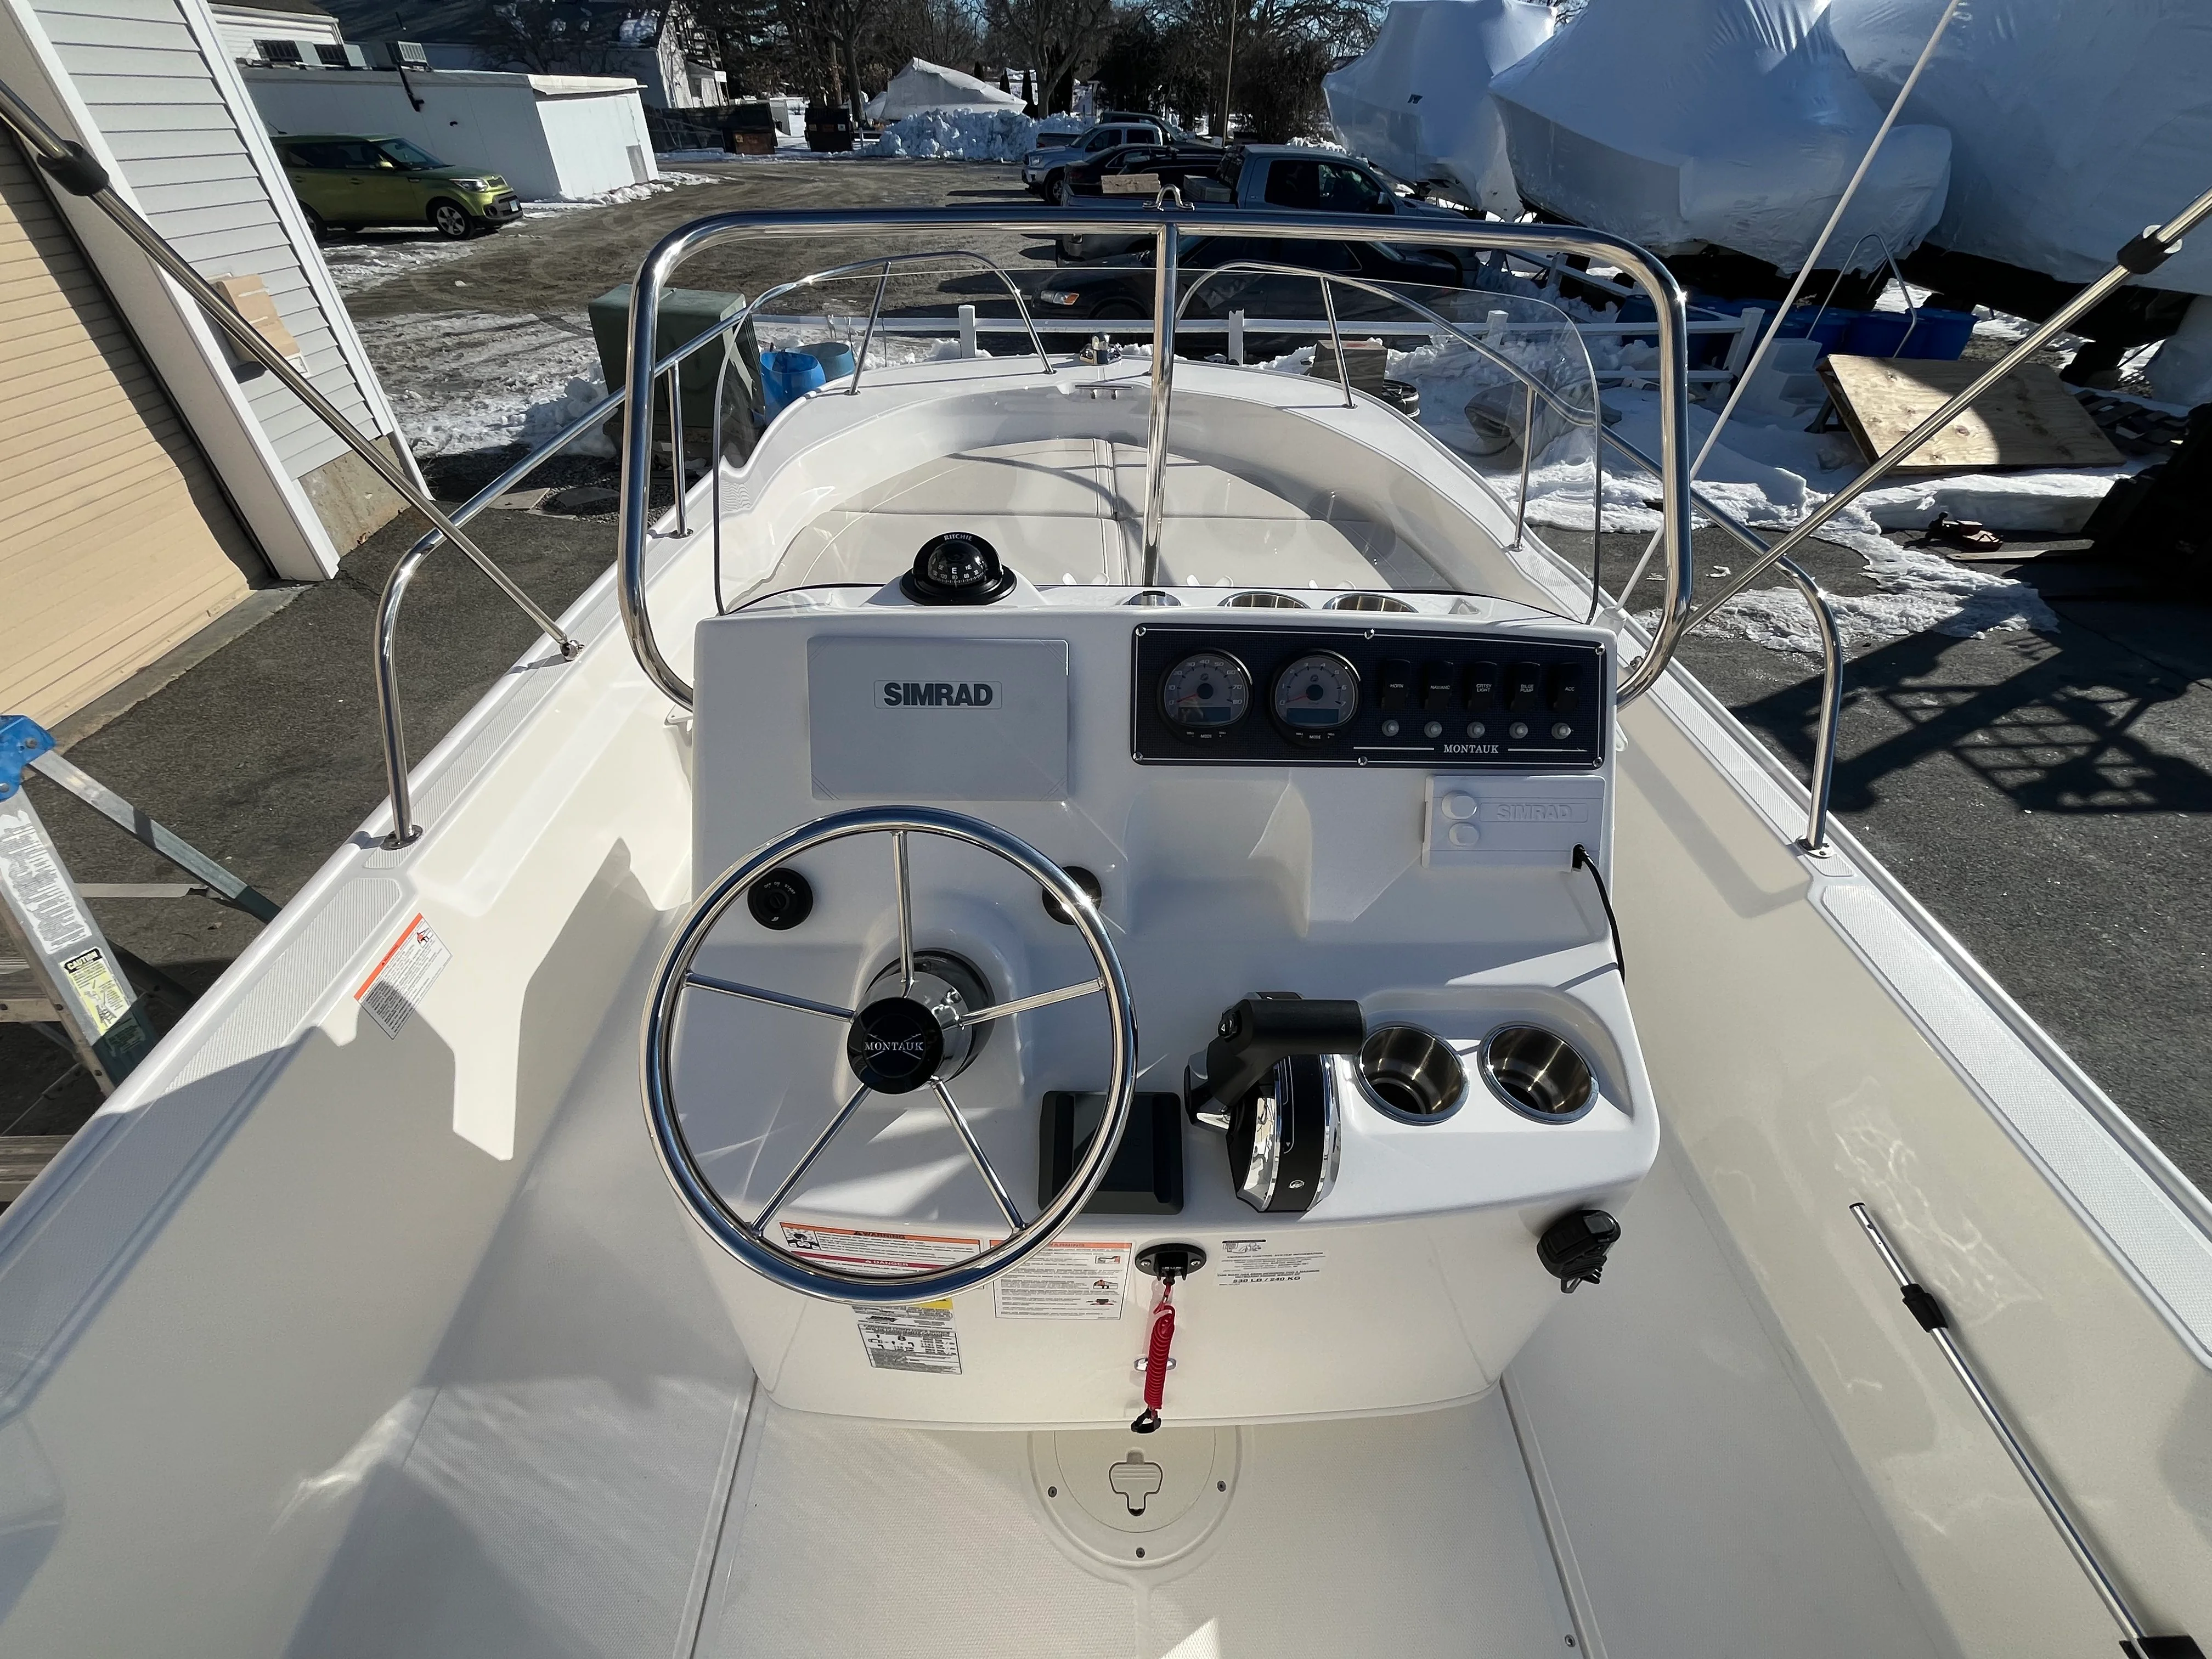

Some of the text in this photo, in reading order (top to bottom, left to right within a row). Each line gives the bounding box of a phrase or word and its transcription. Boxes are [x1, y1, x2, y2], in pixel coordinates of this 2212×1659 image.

[944, 533, 973, 541] RITCHIE
[883, 682, 993, 706] SIMRAD
[1443, 744, 1499, 753] MONTAUK
[1497, 804, 1572, 820] SIMRAD
[785, 884, 796, 894] START
[864, 1042, 924, 1051] MONTAUK
